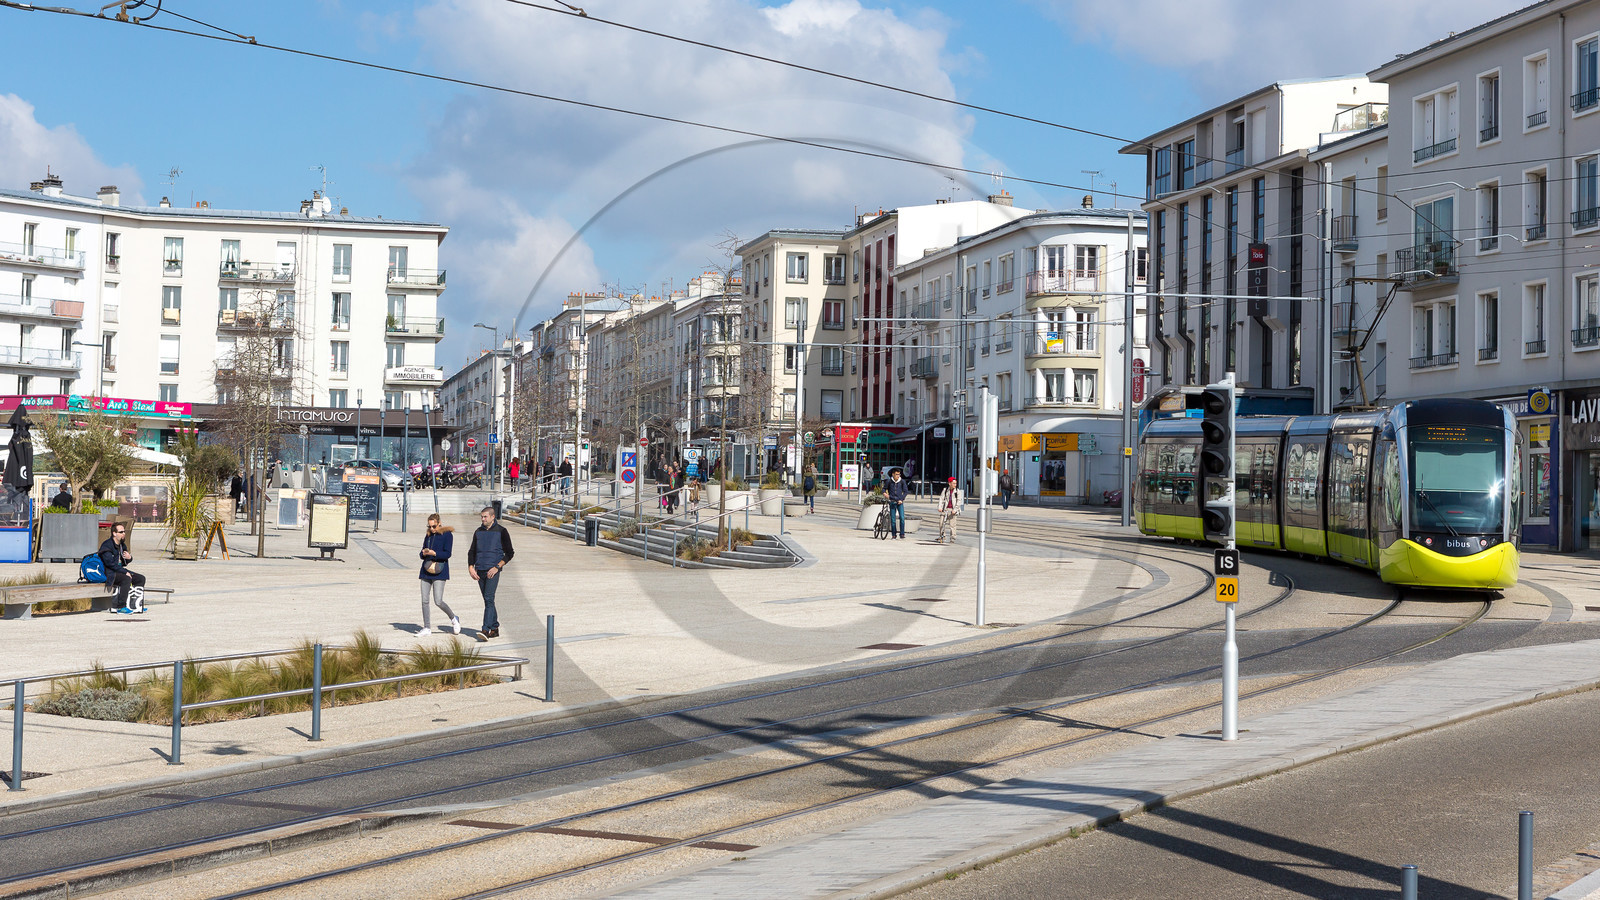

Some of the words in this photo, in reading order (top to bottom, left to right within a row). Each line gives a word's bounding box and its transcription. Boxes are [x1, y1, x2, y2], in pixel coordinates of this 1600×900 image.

[36, 396, 54, 406] Stand
[132, 400, 156, 412] Stand
[1520, 402, 1528, 412] DE
[1447, 539, 1471, 548] bibus
[1220, 555, 1234, 569] IS
[1219, 583, 1235, 596] 20
